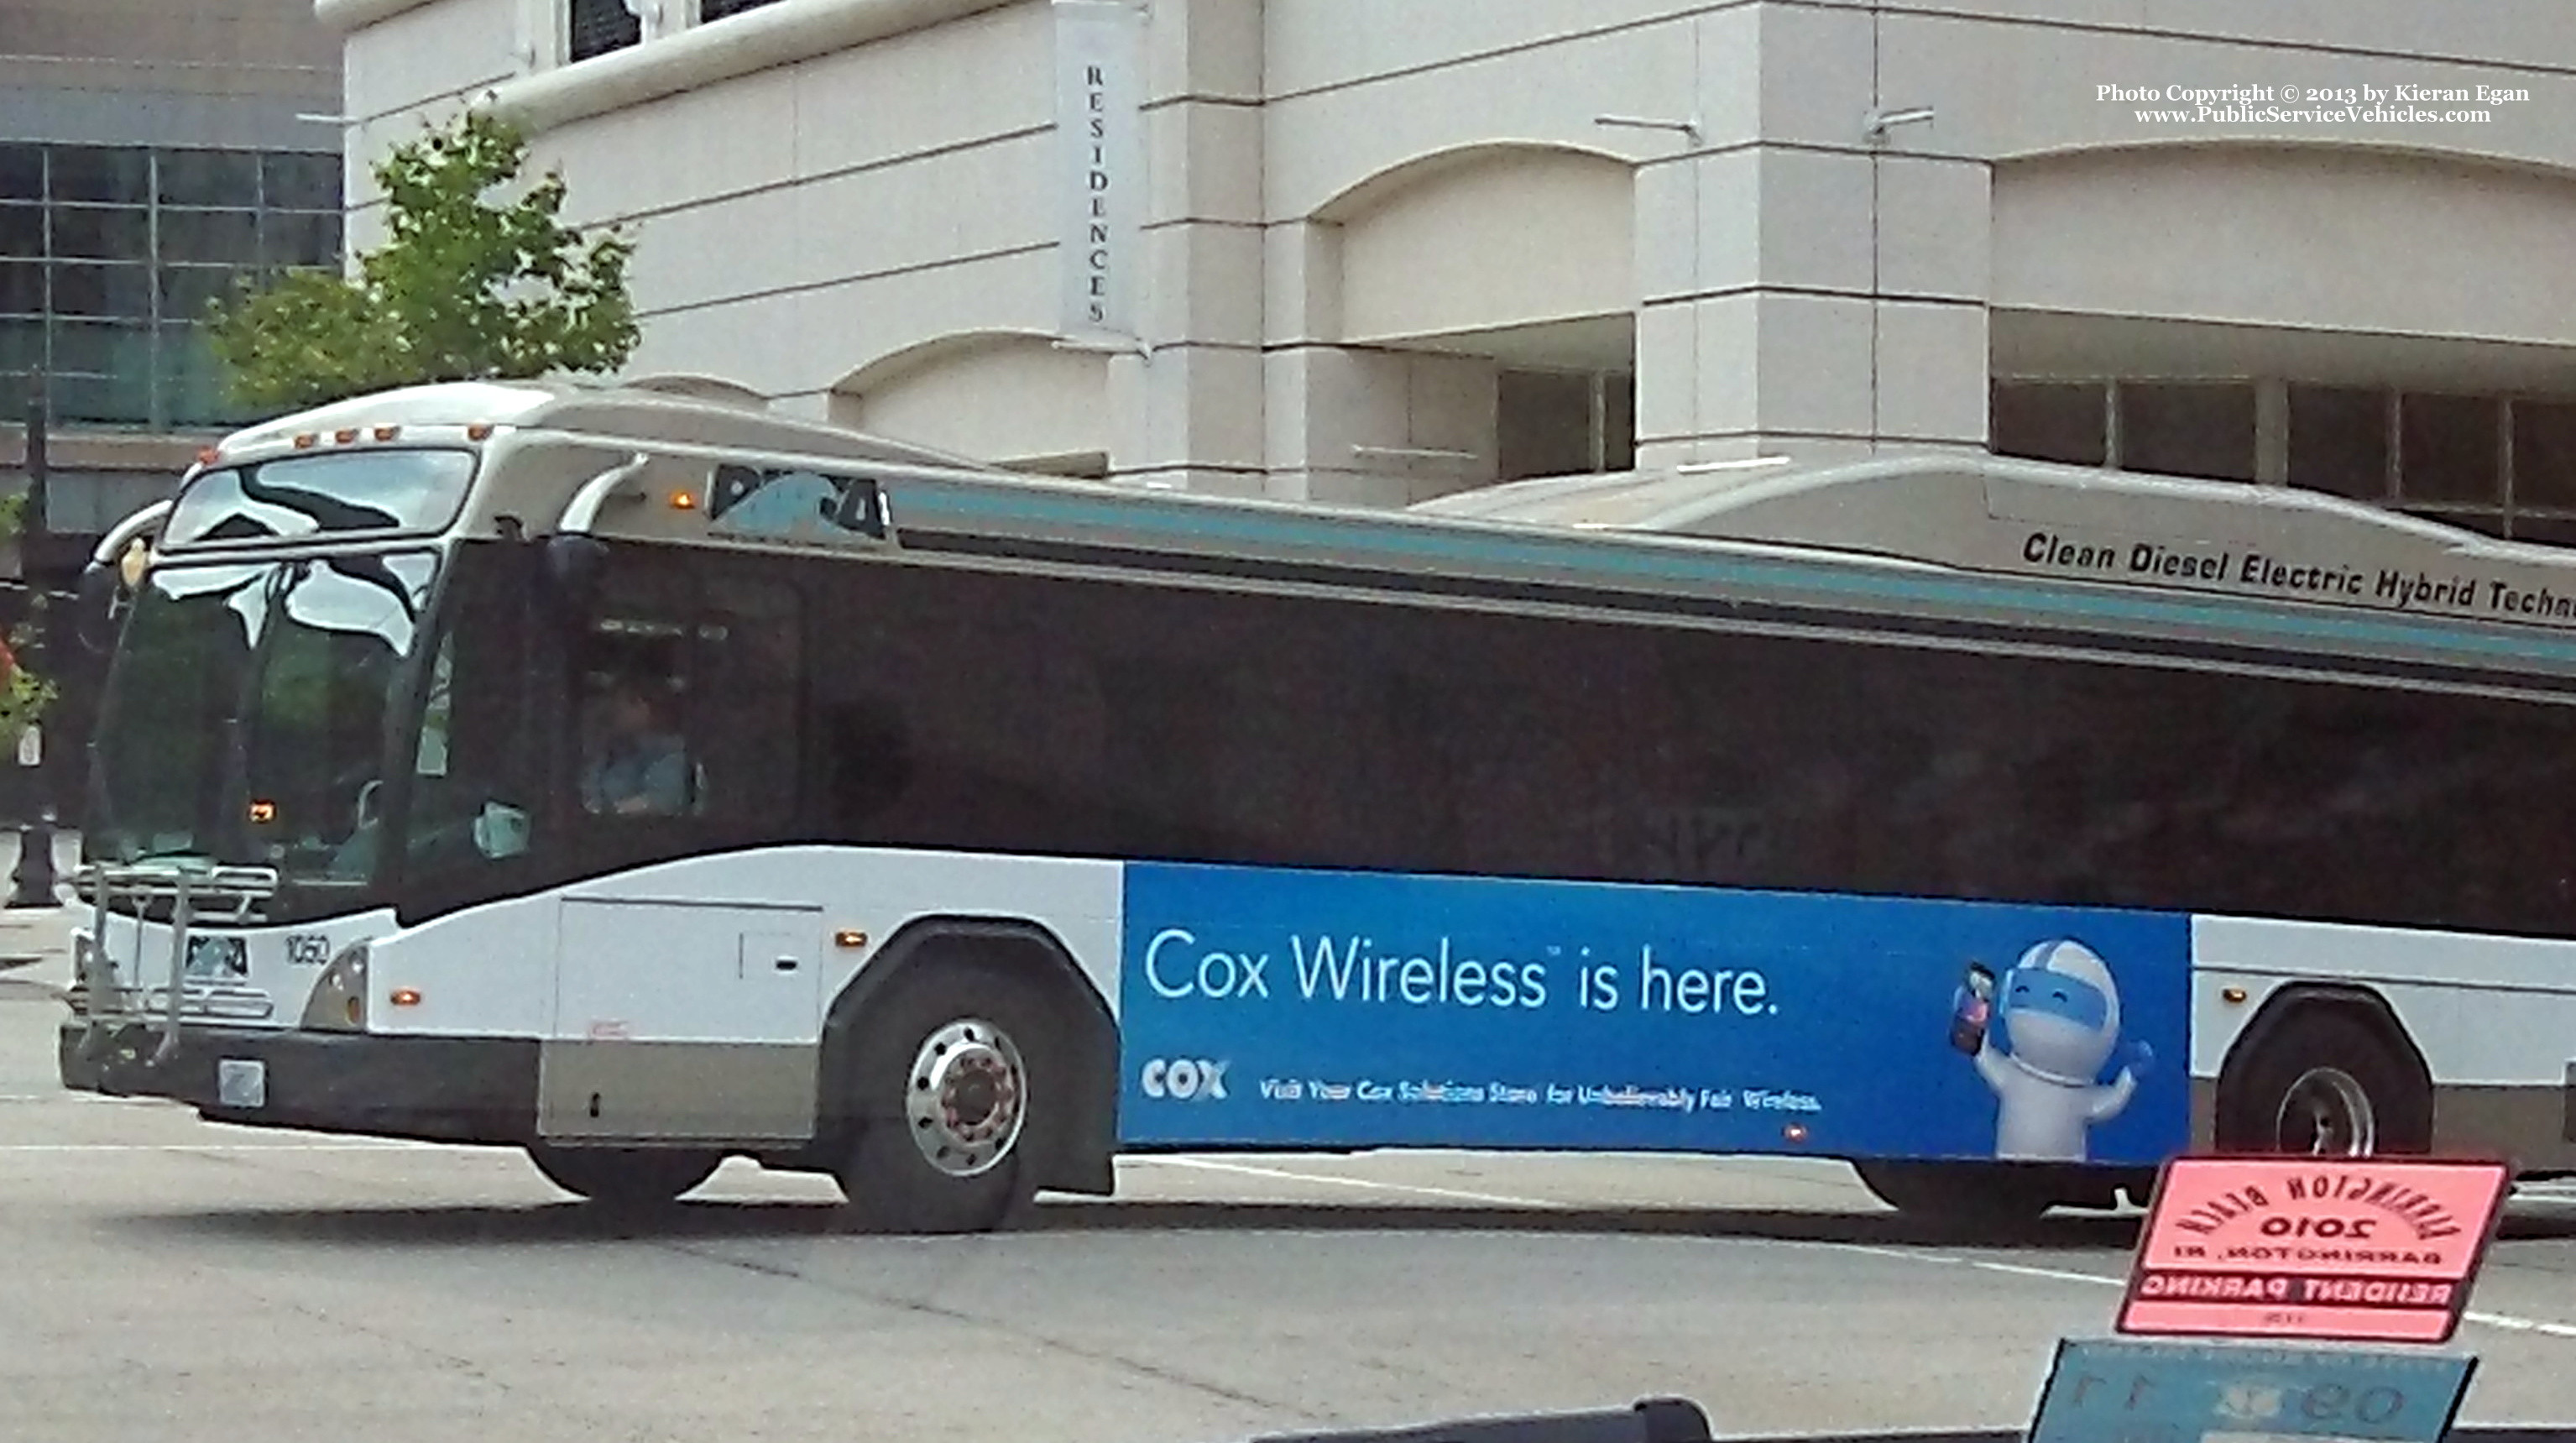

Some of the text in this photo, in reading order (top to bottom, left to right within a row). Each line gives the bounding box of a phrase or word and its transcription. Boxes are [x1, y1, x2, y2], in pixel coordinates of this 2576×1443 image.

[1088, 65, 1108, 322] RESIDENCES
[2024, 532, 2114, 568] Clean
[2129, 543, 2229, 582] Diesel
[2240, 555, 2363, 594] Electric
[2374, 570, 2475, 608] Hybrid
[1145, 929, 1269, 998] Cox
[1580, 947, 1618, 1009] is
[1640, 944, 1779, 1014] here.
